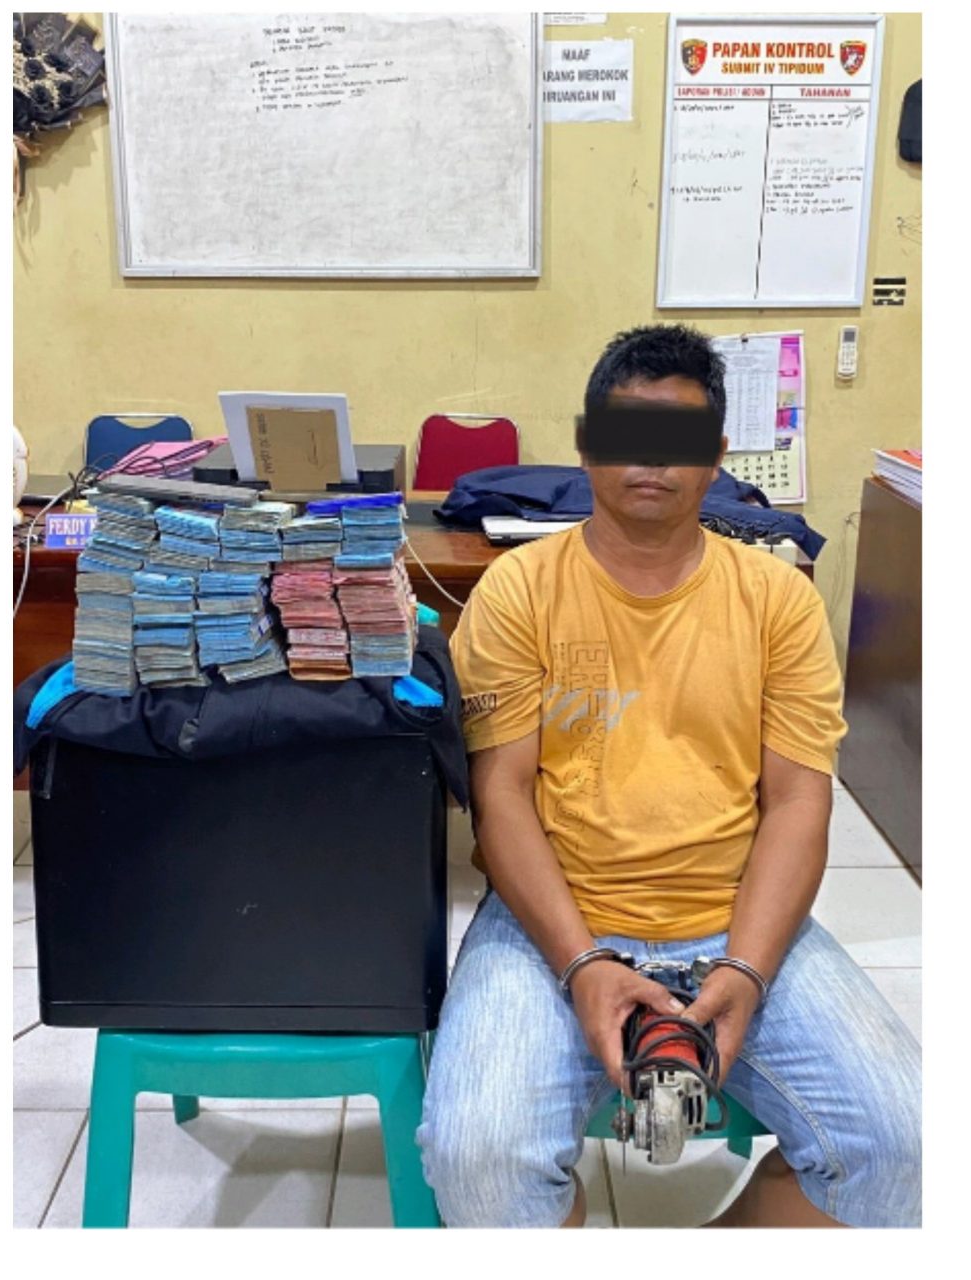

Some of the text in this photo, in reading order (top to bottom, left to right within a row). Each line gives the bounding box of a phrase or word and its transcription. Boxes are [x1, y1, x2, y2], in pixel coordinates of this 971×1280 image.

[562, 48, 590, 61] MAAF
[712, 42, 835, 58] PAPAN KONTROL
[578, 69, 628, 81] MEROKOK
[800, 88, 851, 97] TAHANAN
[50, 518, 86, 535] FERDY
